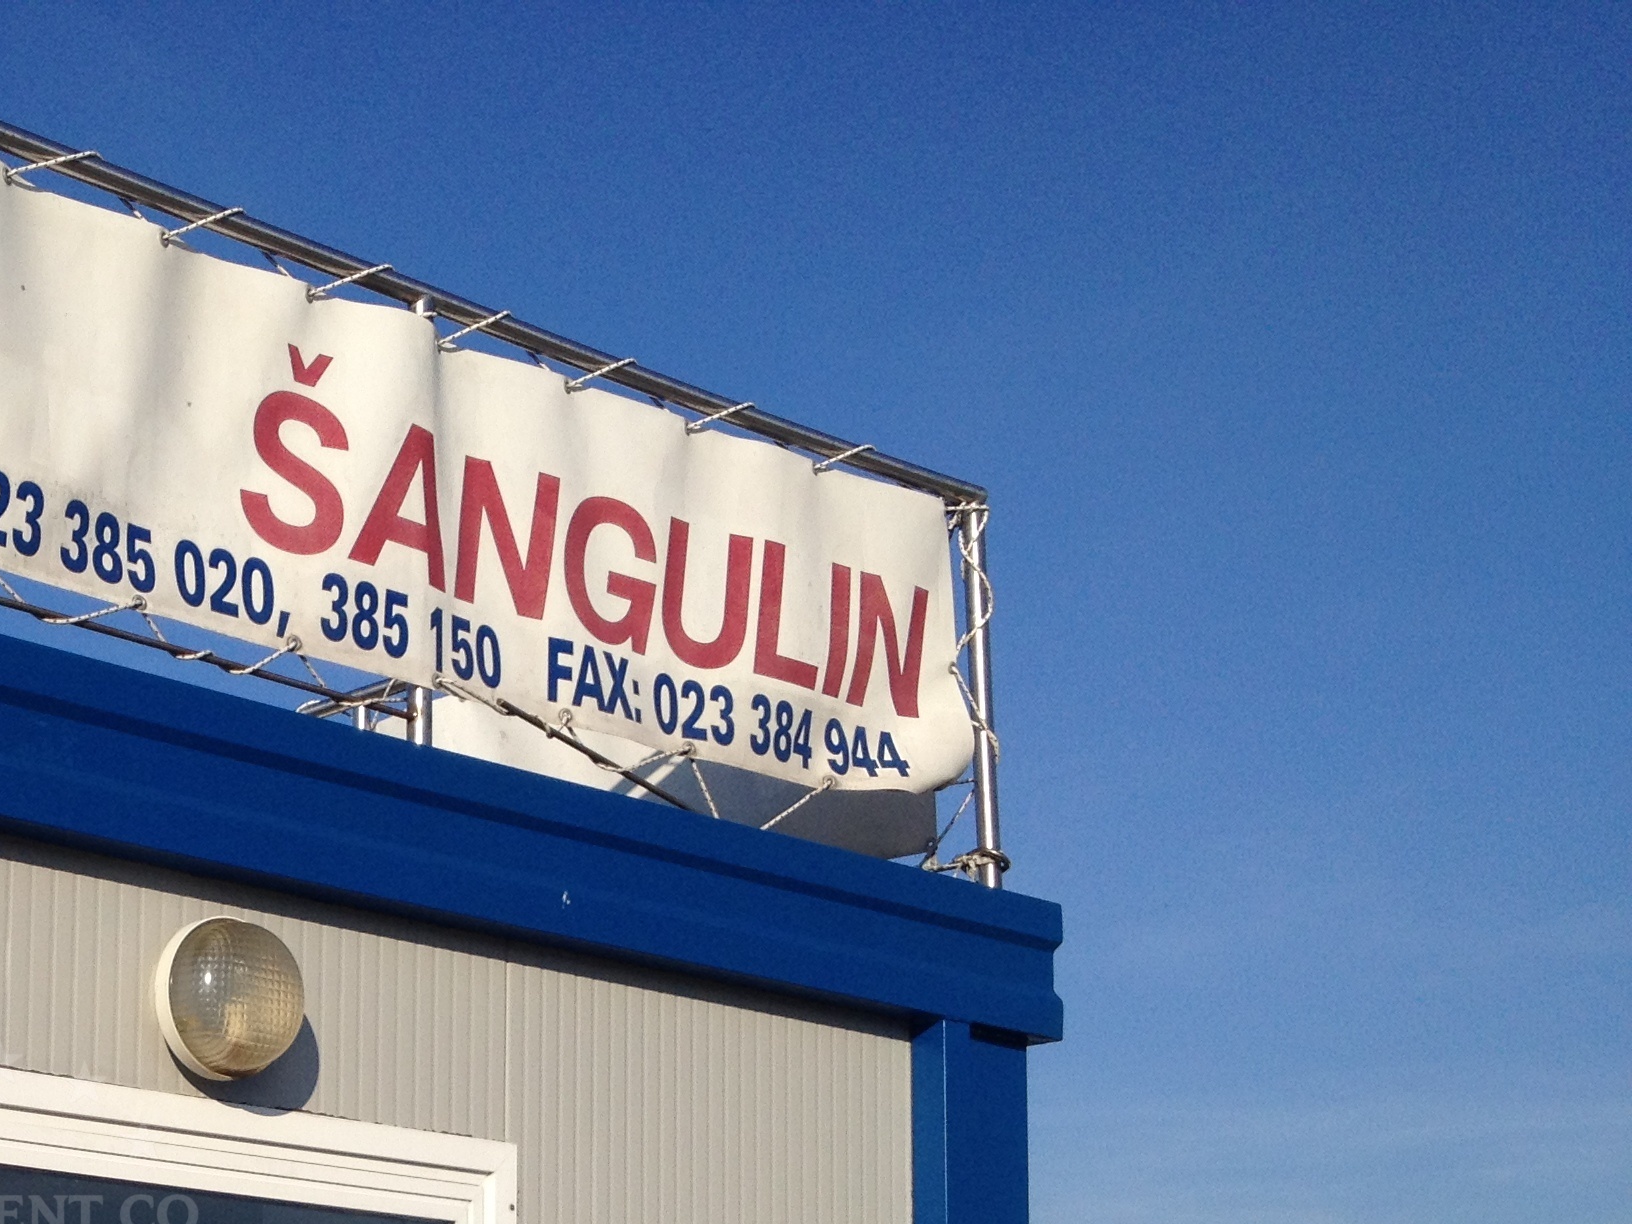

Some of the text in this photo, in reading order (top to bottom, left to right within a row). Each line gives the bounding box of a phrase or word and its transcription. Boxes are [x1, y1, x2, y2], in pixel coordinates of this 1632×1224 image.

[60, 499, 156, 593] 385
[174, 538, 291, 637] 020,
[321, 573, 409, 658] 385
[430, 608, 502, 688] 150
[548, 637, 643, 722] FAX:
[653, 673, 736, 745] 023
[750, 693, 812, 769] 384
[824, 719, 910, 776] 944
[240, 343, 929, 718] ŠANGULIN
